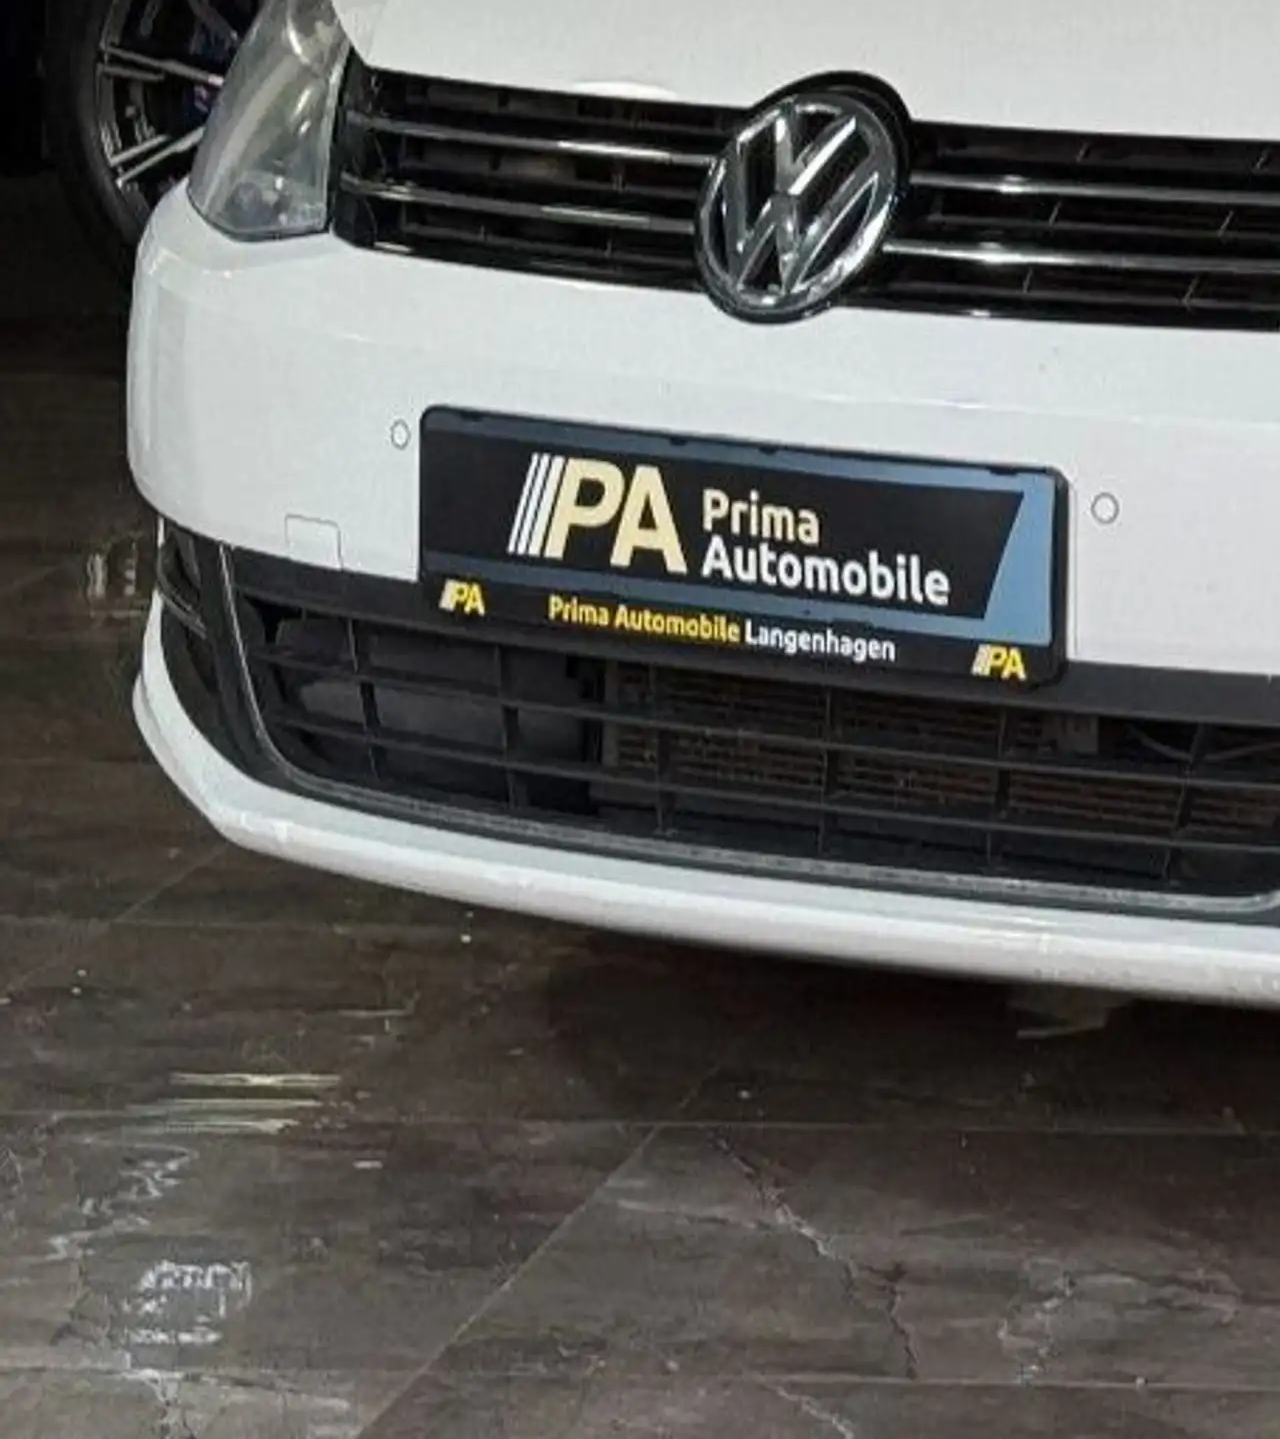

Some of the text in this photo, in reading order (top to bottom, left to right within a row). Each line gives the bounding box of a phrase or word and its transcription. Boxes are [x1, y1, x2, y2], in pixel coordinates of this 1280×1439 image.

[702, 488, 820, 545] Prima
[702, 534, 950, 606] Automobile
[548, 594, 896, 663] Prima Automobile Langenhagen
